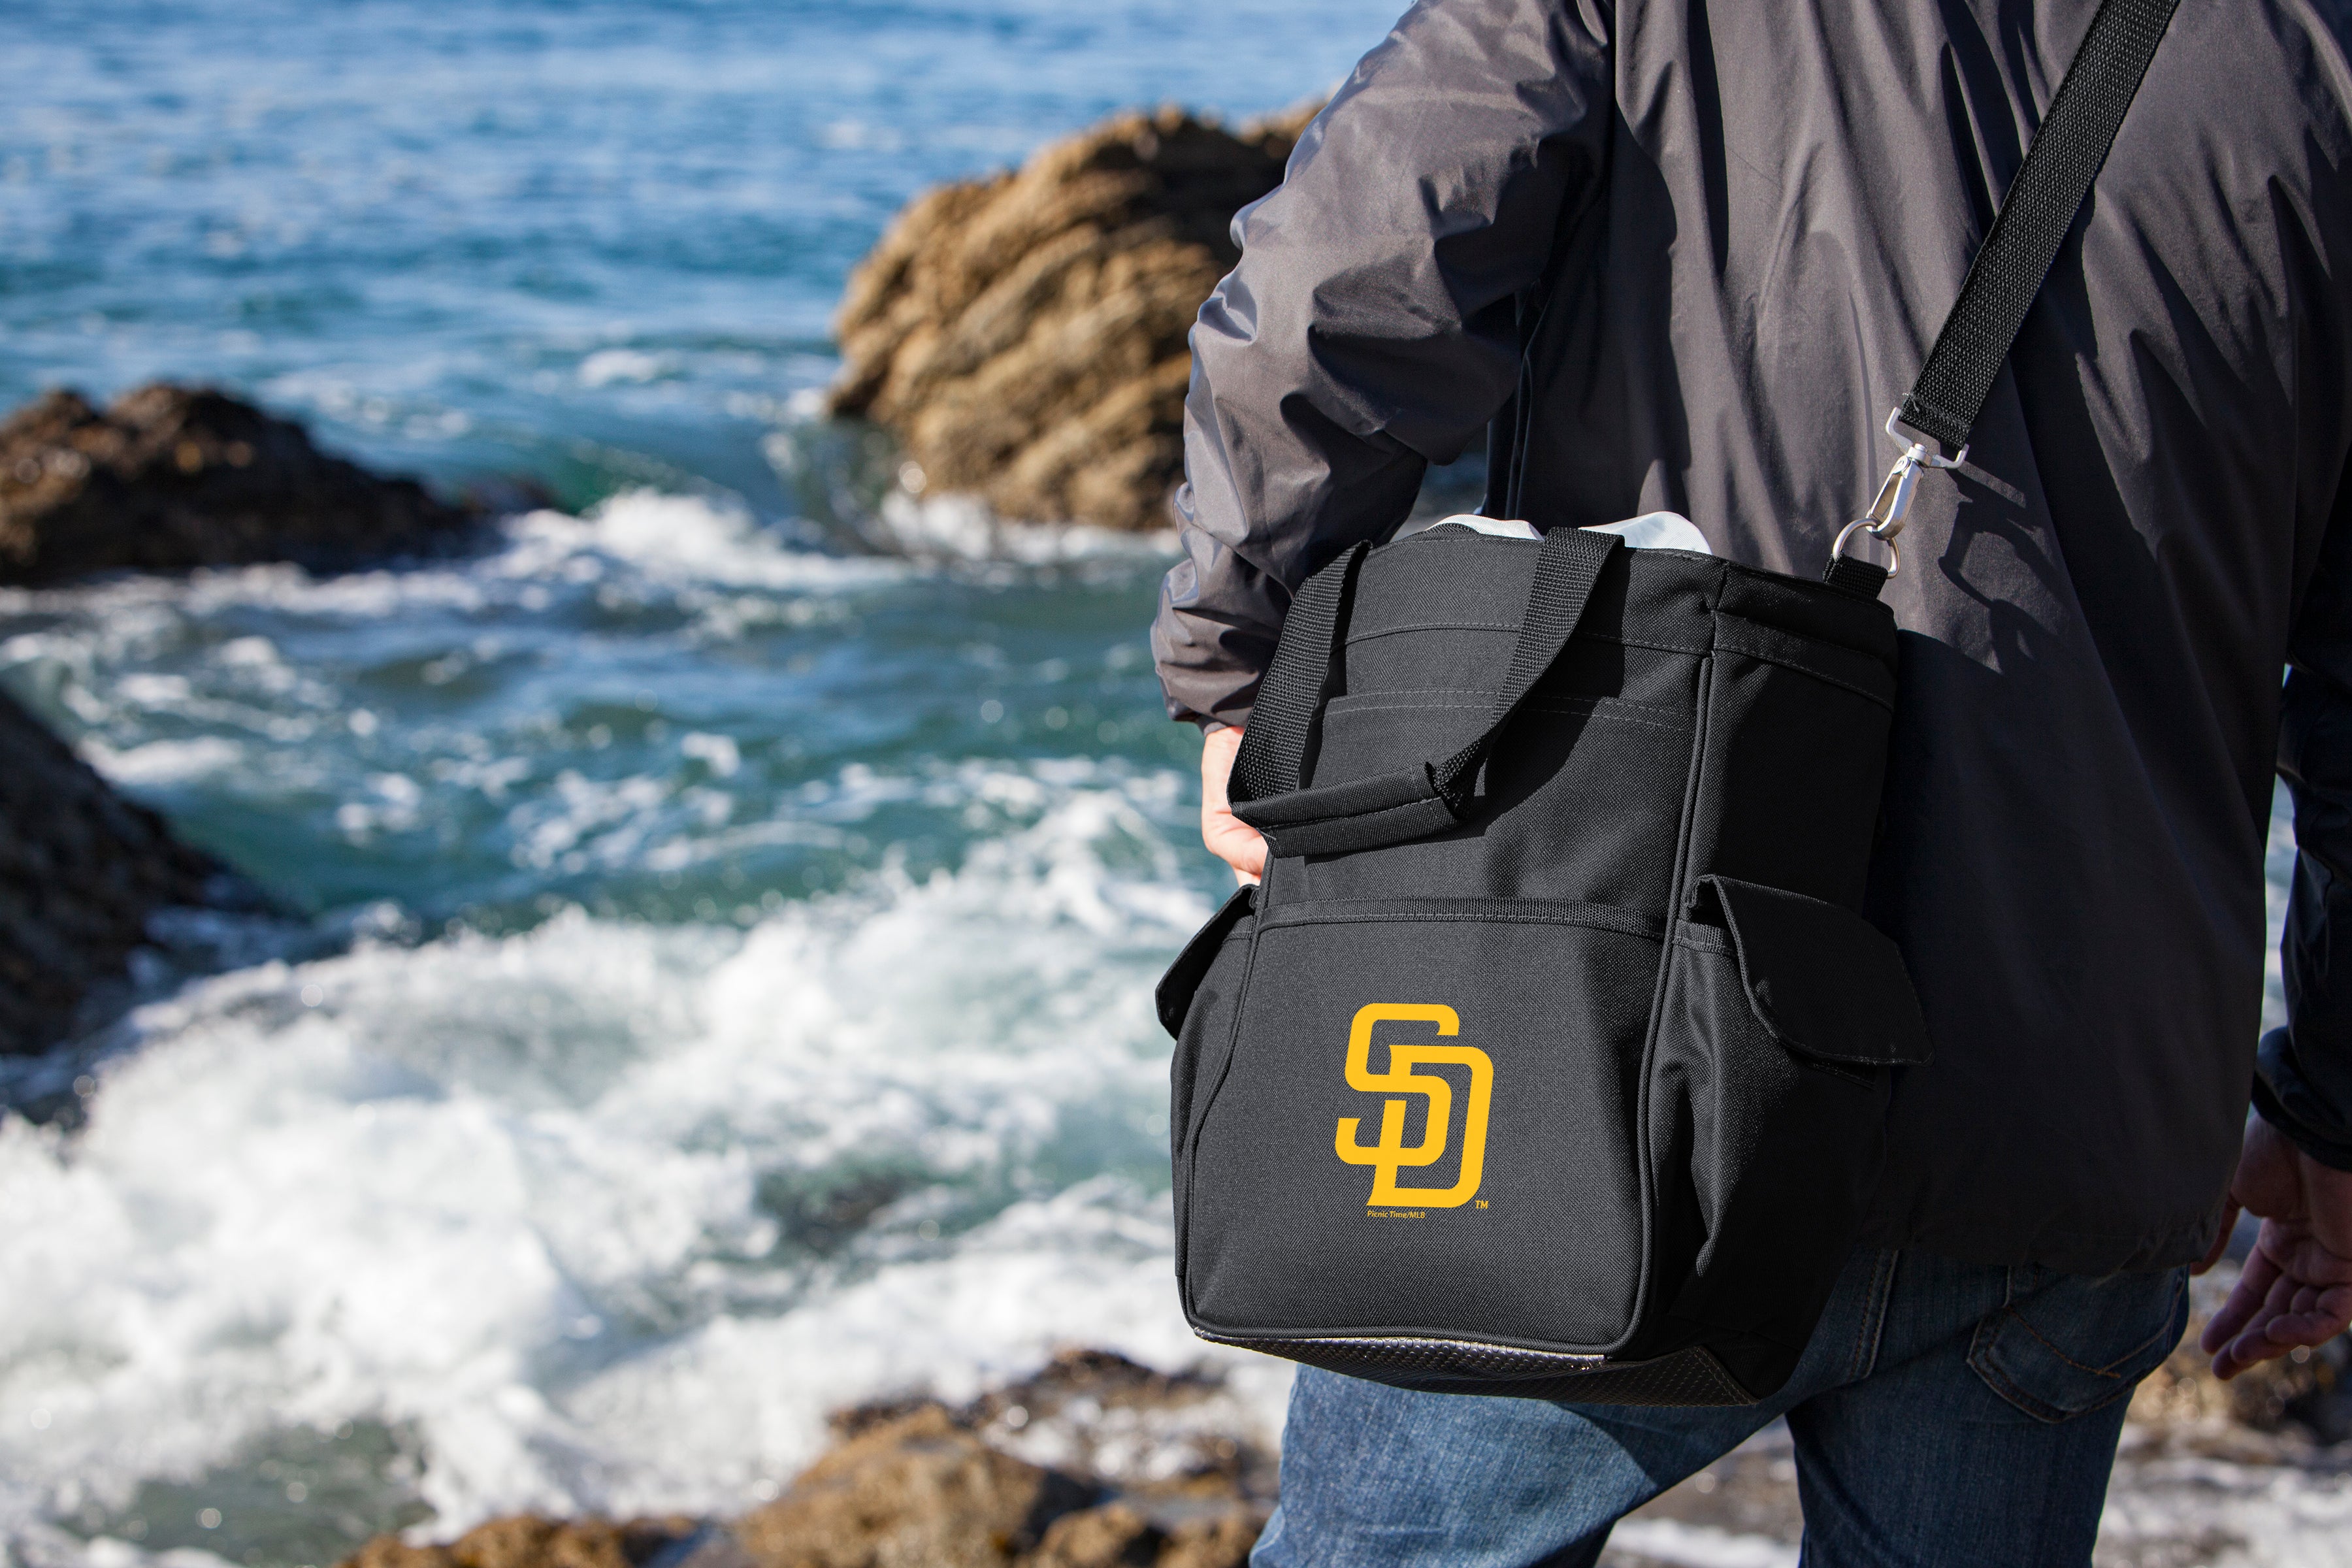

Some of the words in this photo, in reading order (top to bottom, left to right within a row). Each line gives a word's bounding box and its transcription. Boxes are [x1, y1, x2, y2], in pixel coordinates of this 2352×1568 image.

[1335, 1003, 1494, 1208] SD
[1475, 1200, 1489, 1209] TM
[1367, 1210, 1388, 1218] Picnic
[1390, 1211, 1426, 1219] Time/MLB
